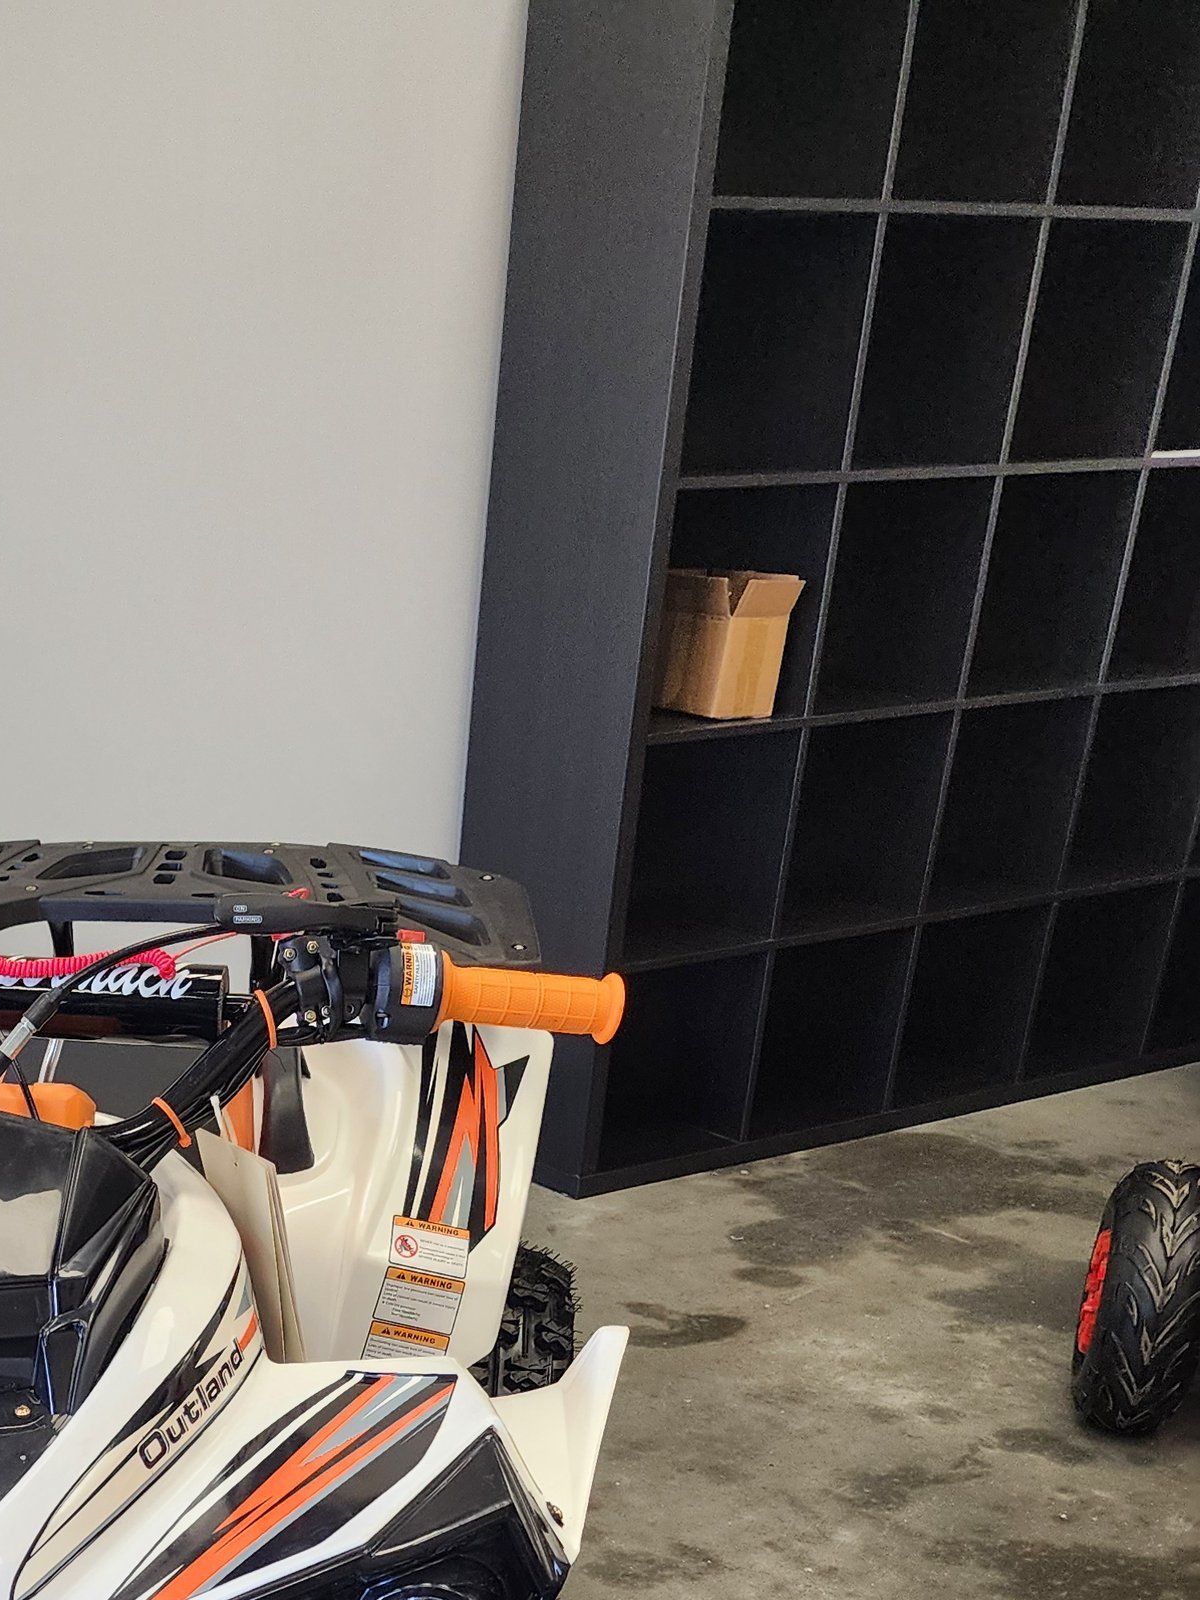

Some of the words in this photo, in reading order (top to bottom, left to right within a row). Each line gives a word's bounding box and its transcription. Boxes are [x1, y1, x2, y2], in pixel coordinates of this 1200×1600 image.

[418, 1221, 460, 1236] WARNING
[410, 1274, 453, 1290] WARNING
[393, 1329, 436, 1344] WARNING
[137, 1338, 245, 1471] Outland
